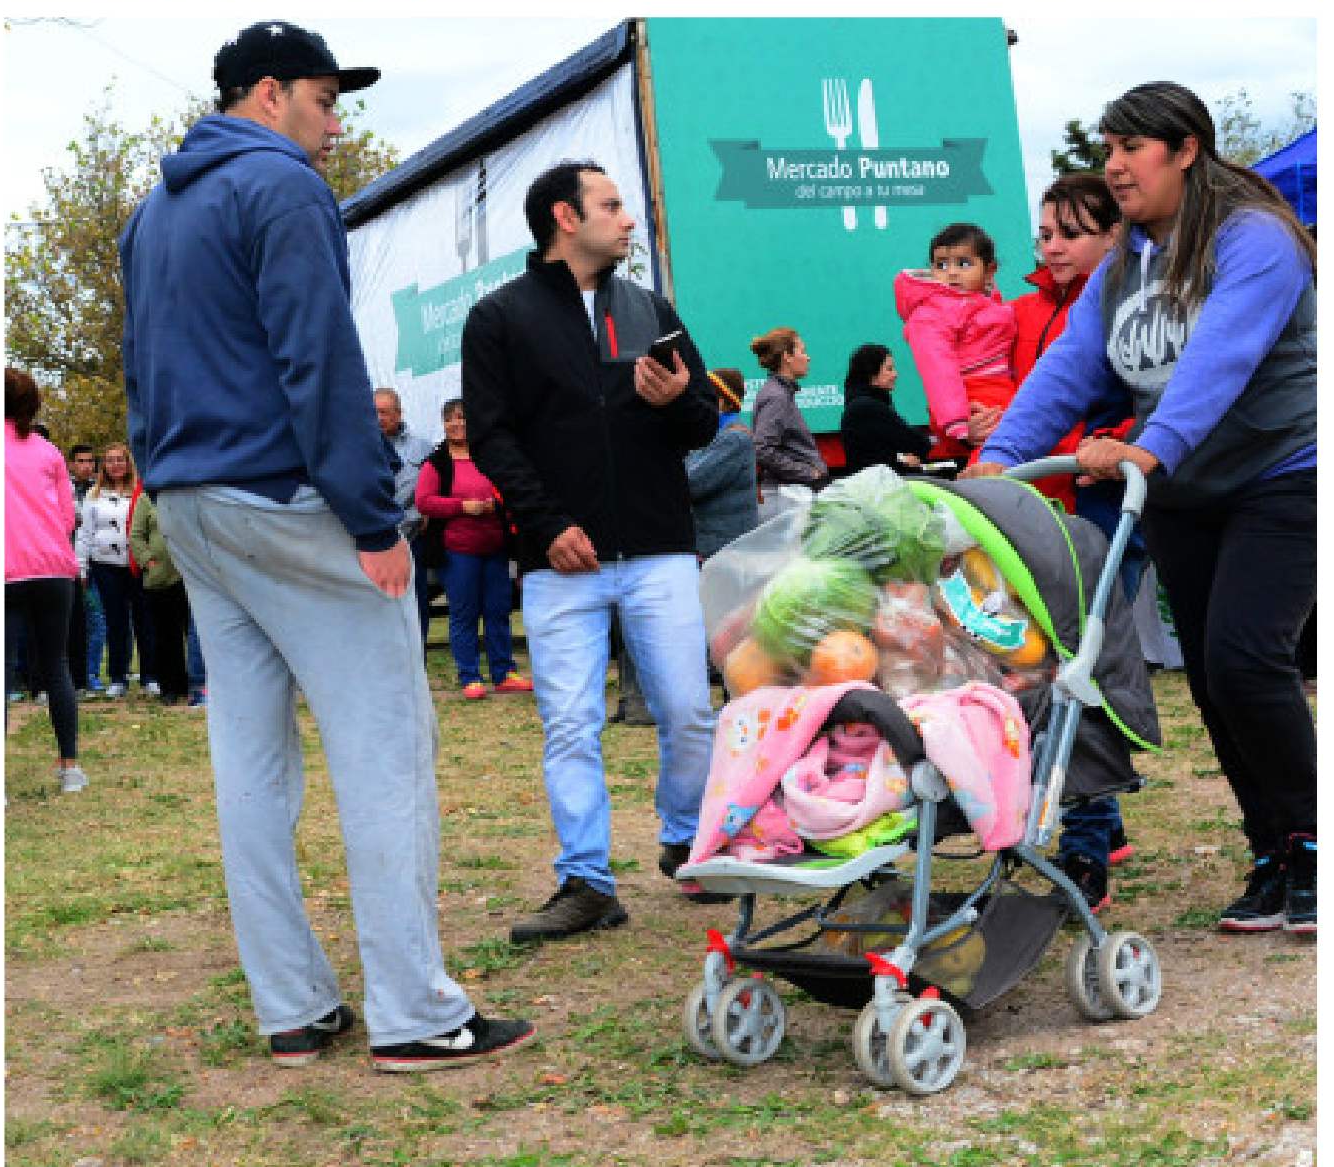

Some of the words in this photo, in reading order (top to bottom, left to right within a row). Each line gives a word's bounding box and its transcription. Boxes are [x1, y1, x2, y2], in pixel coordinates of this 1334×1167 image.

[767, 155, 853, 179] Mercado
[858, 157, 950, 179] Puntano
[795, 184, 816, 199] del
[818, 185, 862, 200] campo
[865, 185, 873, 196] a
[878, 185, 890, 196] tu
[892, 185, 924, 196] mesa
